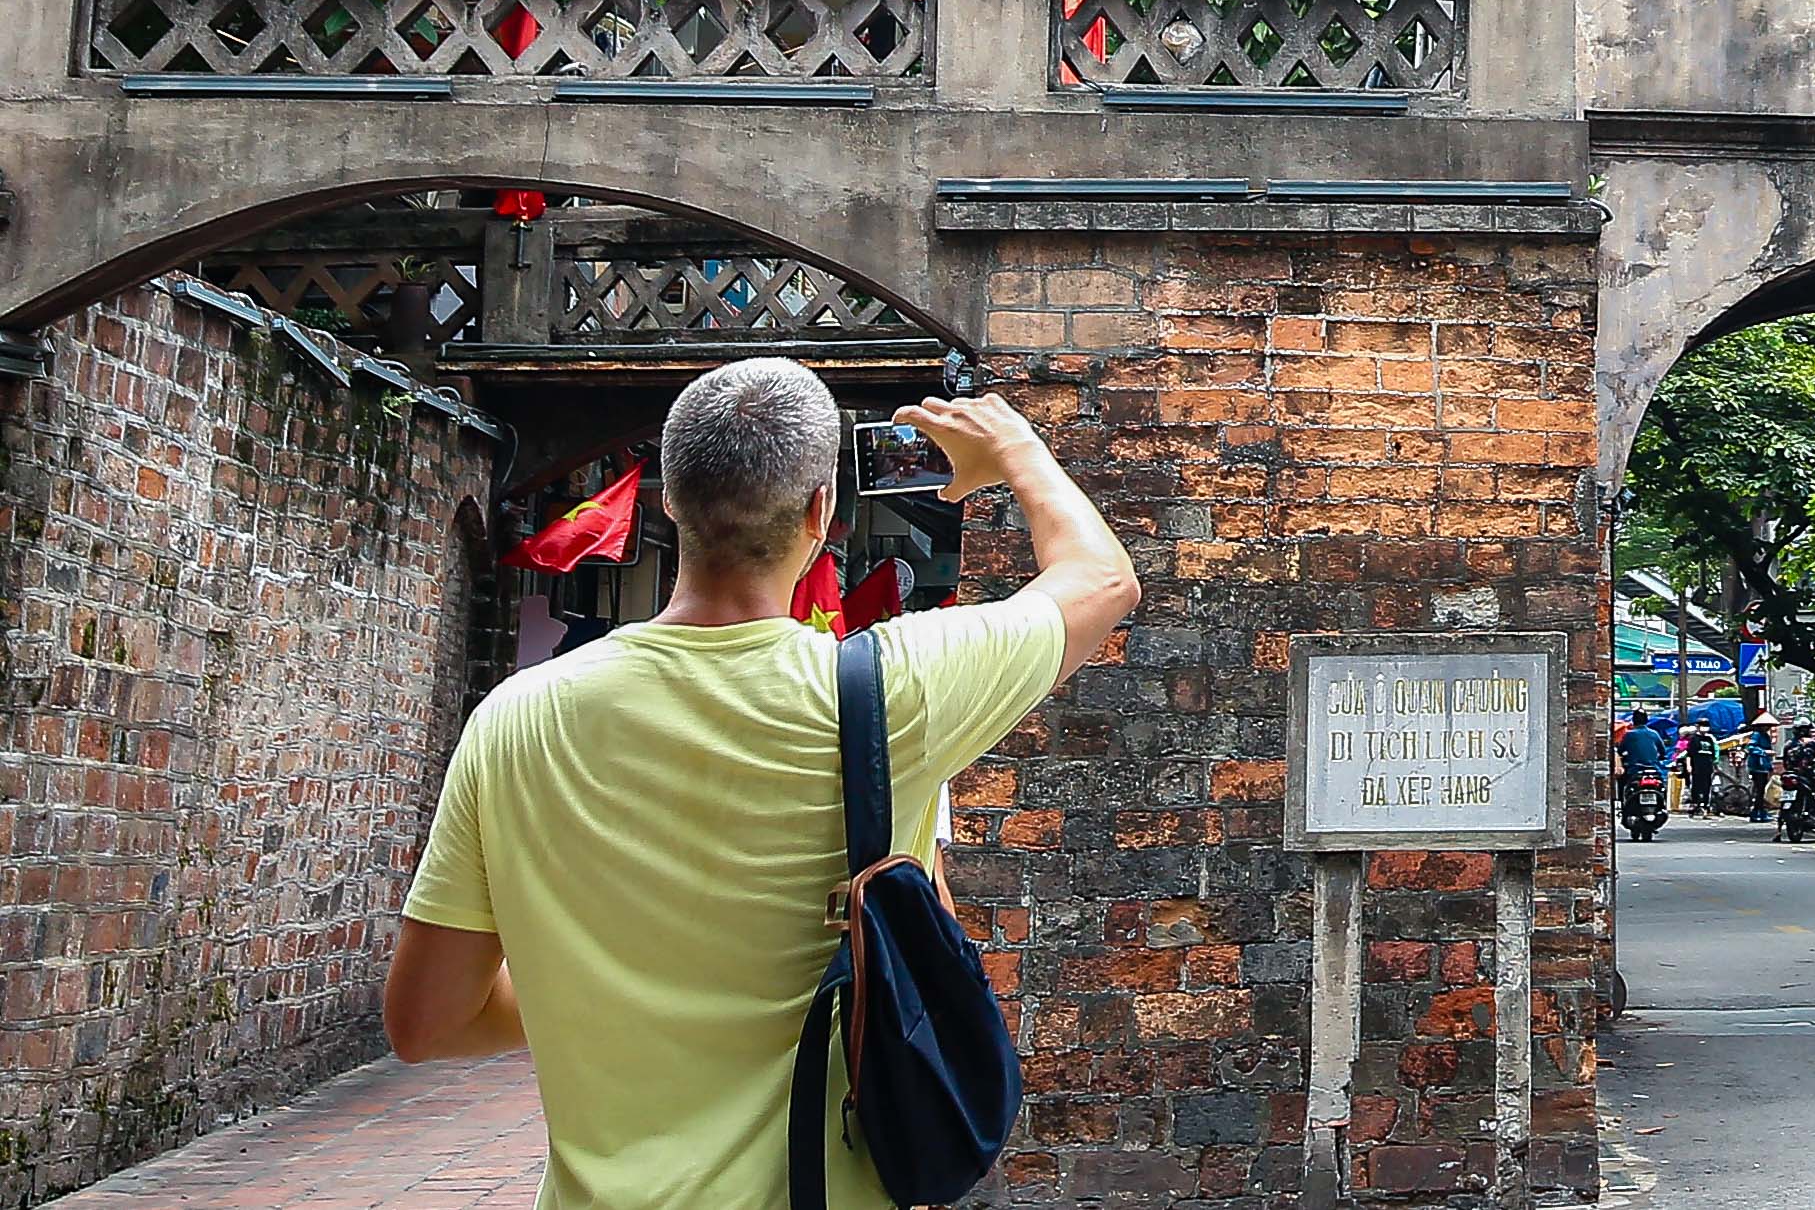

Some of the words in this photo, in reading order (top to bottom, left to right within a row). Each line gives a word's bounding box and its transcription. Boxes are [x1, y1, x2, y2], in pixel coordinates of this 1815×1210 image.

[1394, 678, 1446, 716] QUAN
[1452, 667, 1529, 714] CHƯỞNG
[1331, 731, 1353, 761] DI
[1424, 730, 1484, 764] LỊCH
[1441, 775, 1491, 810] HẠNG
